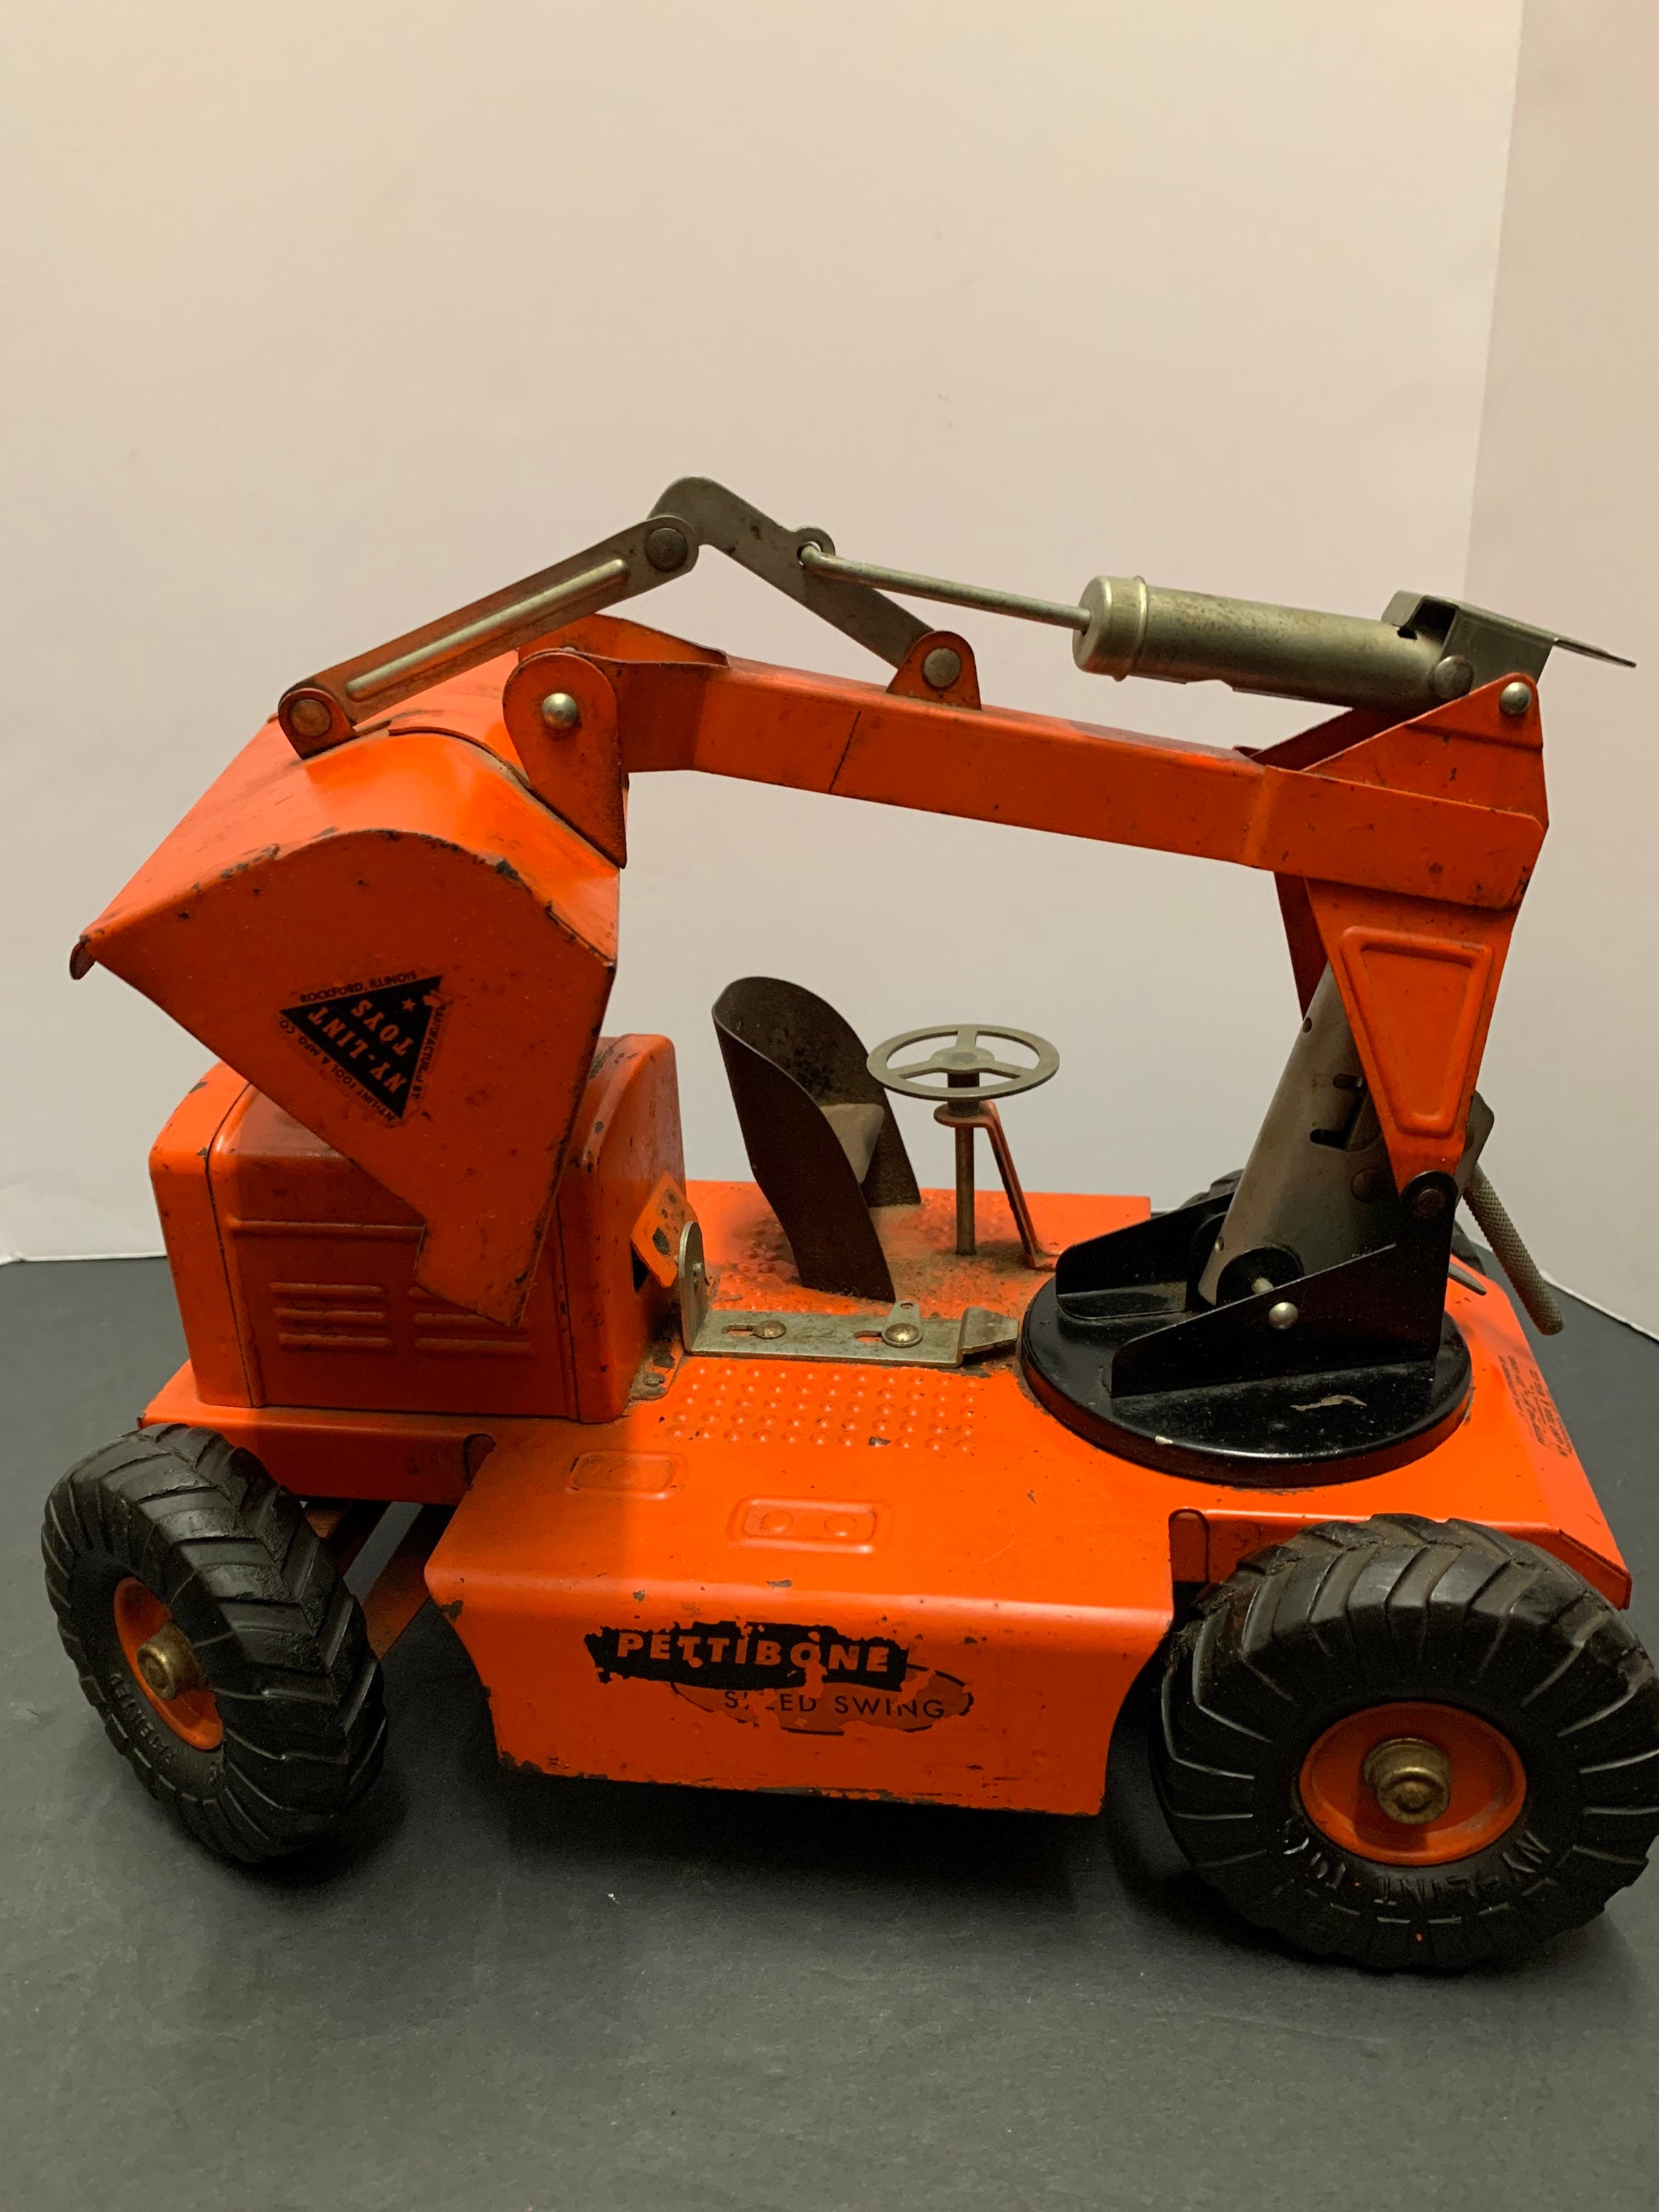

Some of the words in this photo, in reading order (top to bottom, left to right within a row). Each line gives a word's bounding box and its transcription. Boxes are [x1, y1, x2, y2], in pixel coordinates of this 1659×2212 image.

[351, 1000, 413, 1056] TOYS
[308, 1006, 407, 1093] NY-LINT
[330, 1064, 356, 1090] TOOL
[617, 1632, 890, 1673] PETTIBONE
[725, 1690, 817, 1713] SED
[834, 1694, 946, 1720] SWING
